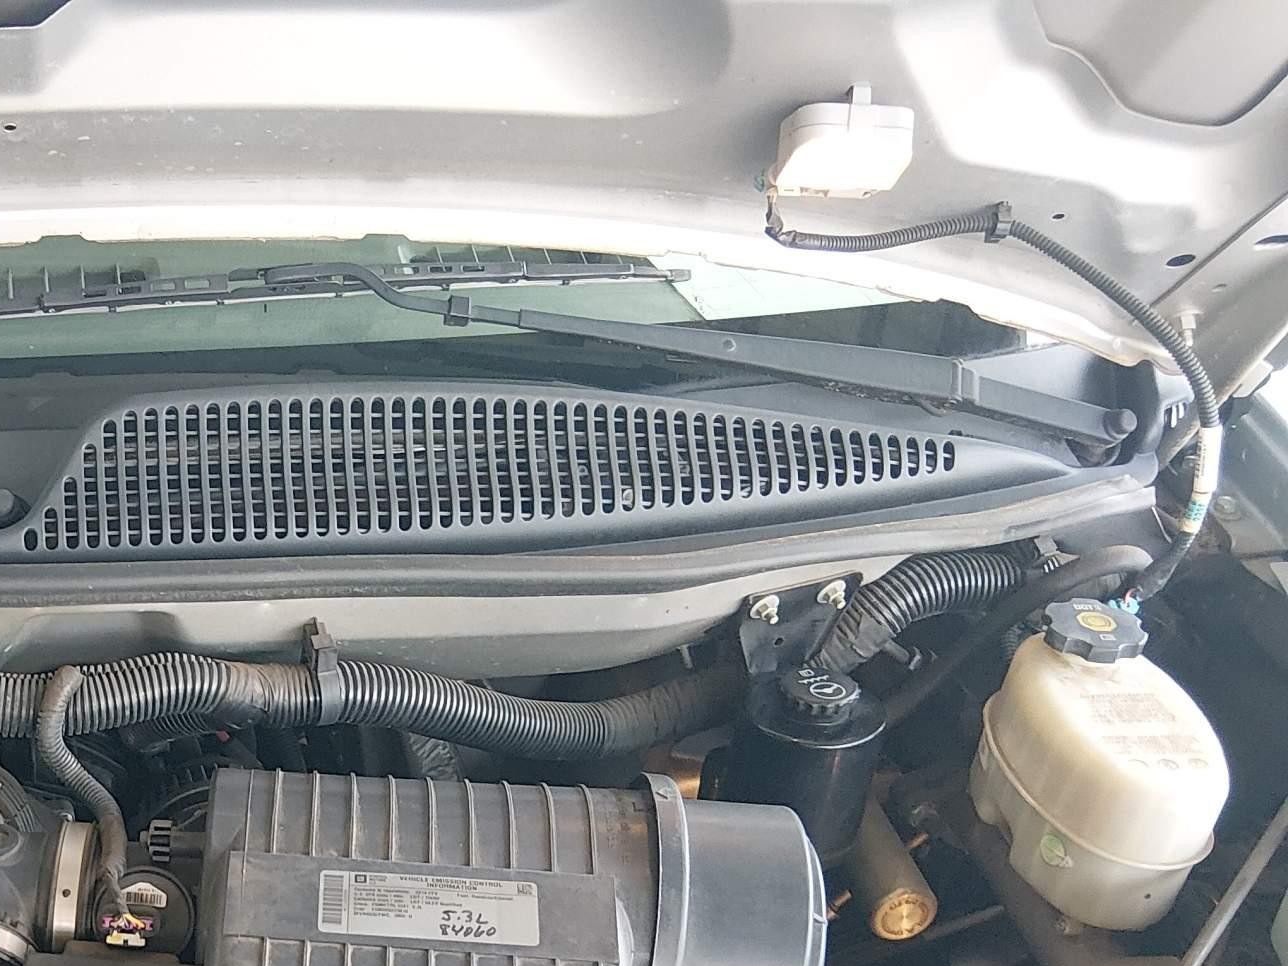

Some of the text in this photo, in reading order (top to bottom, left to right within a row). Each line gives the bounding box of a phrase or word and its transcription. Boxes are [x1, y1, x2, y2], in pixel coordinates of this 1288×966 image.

[426, 882, 478, 891] INFORMATION
[431, 877, 467, 885] EMISSION
[469, 880, 503, 888] CONTROL
